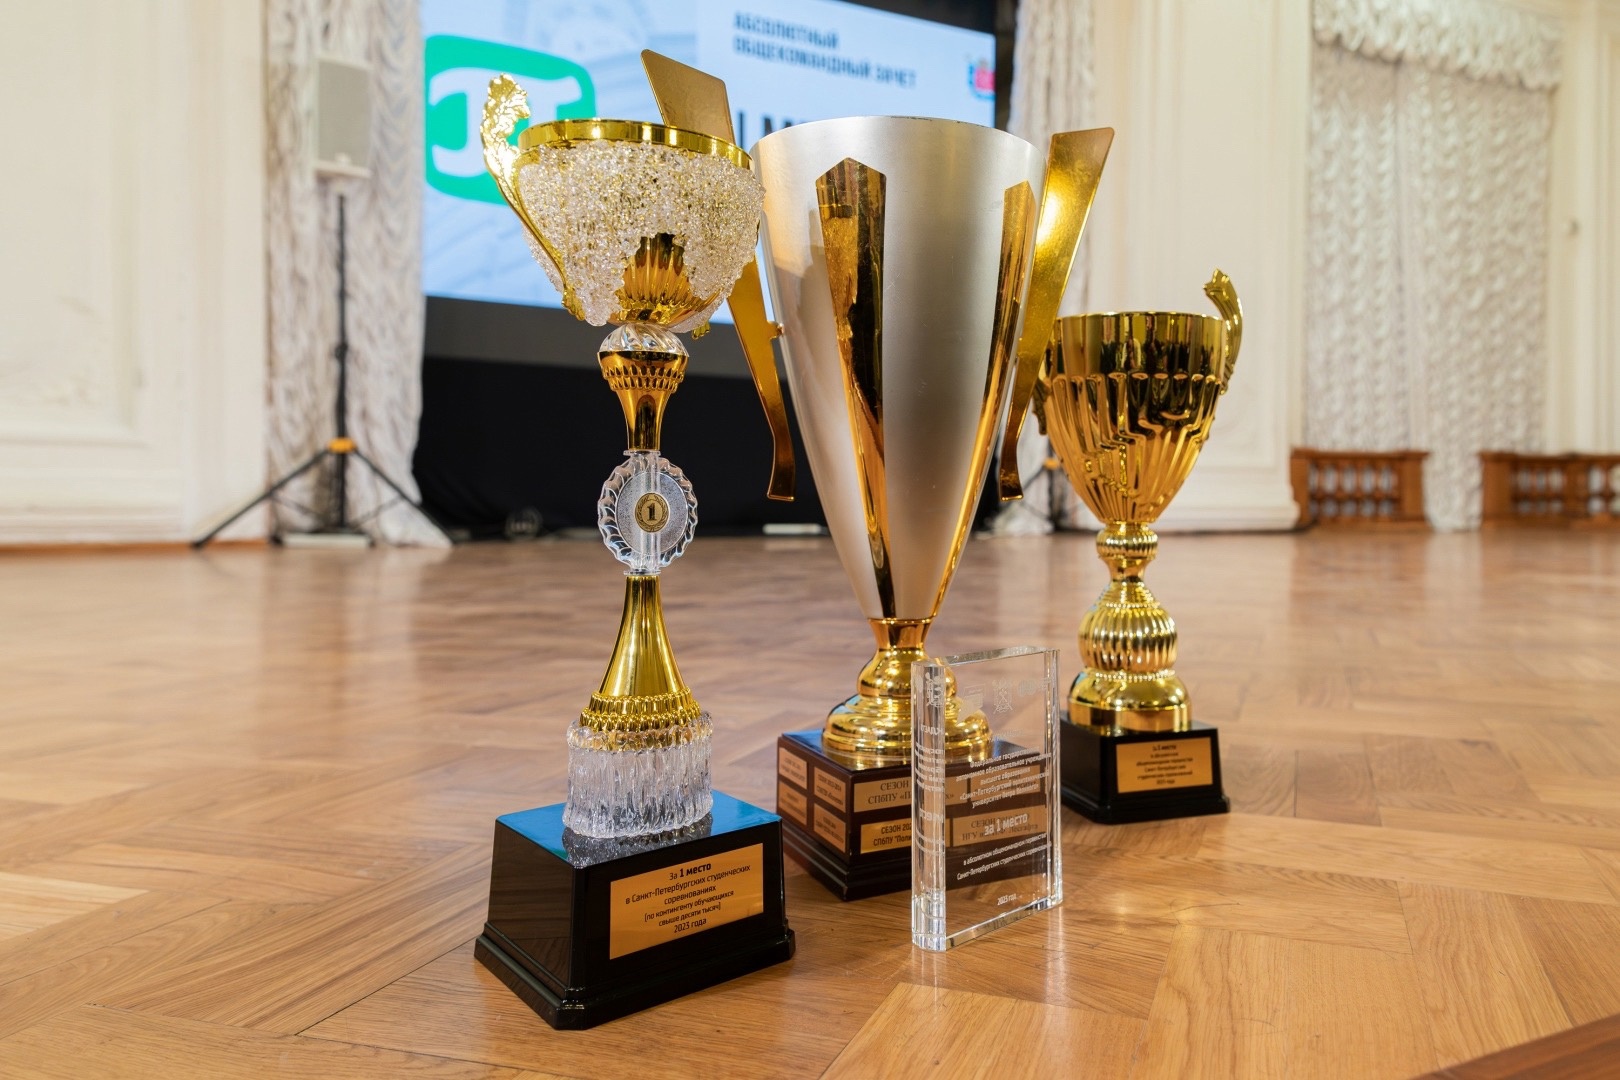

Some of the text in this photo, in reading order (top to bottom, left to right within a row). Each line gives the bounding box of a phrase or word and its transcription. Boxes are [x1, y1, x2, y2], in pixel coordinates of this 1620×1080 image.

[647, 503, 657, 521] 1
[880, 780, 909, 791] СЕЗОН
[867, 793, 898, 805] СПбПУ
[881, 824, 901, 835] СЕЗОН
[984, 824, 994, 836] за
[996, 819, 1001, 832] 1
[1002, 813, 1028, 830] место
[873, 835, 893, 847] СПбПУ
[962, 831, 978, 841] НГУ
[669, 862, 712, 881] За 1 место
[625, 864, 751, 905] в Санкт-Петербургских студенческих
[664, 885, 717, 905] соревнованиях
[655, 901, 694, 919] контингенту
[694, 890, 734, 907] обучающихся
[658, 915, 680, 927] свыше
[680, 909, 701, 922] десяти
[674, 918, 707, 933] 2023 года
